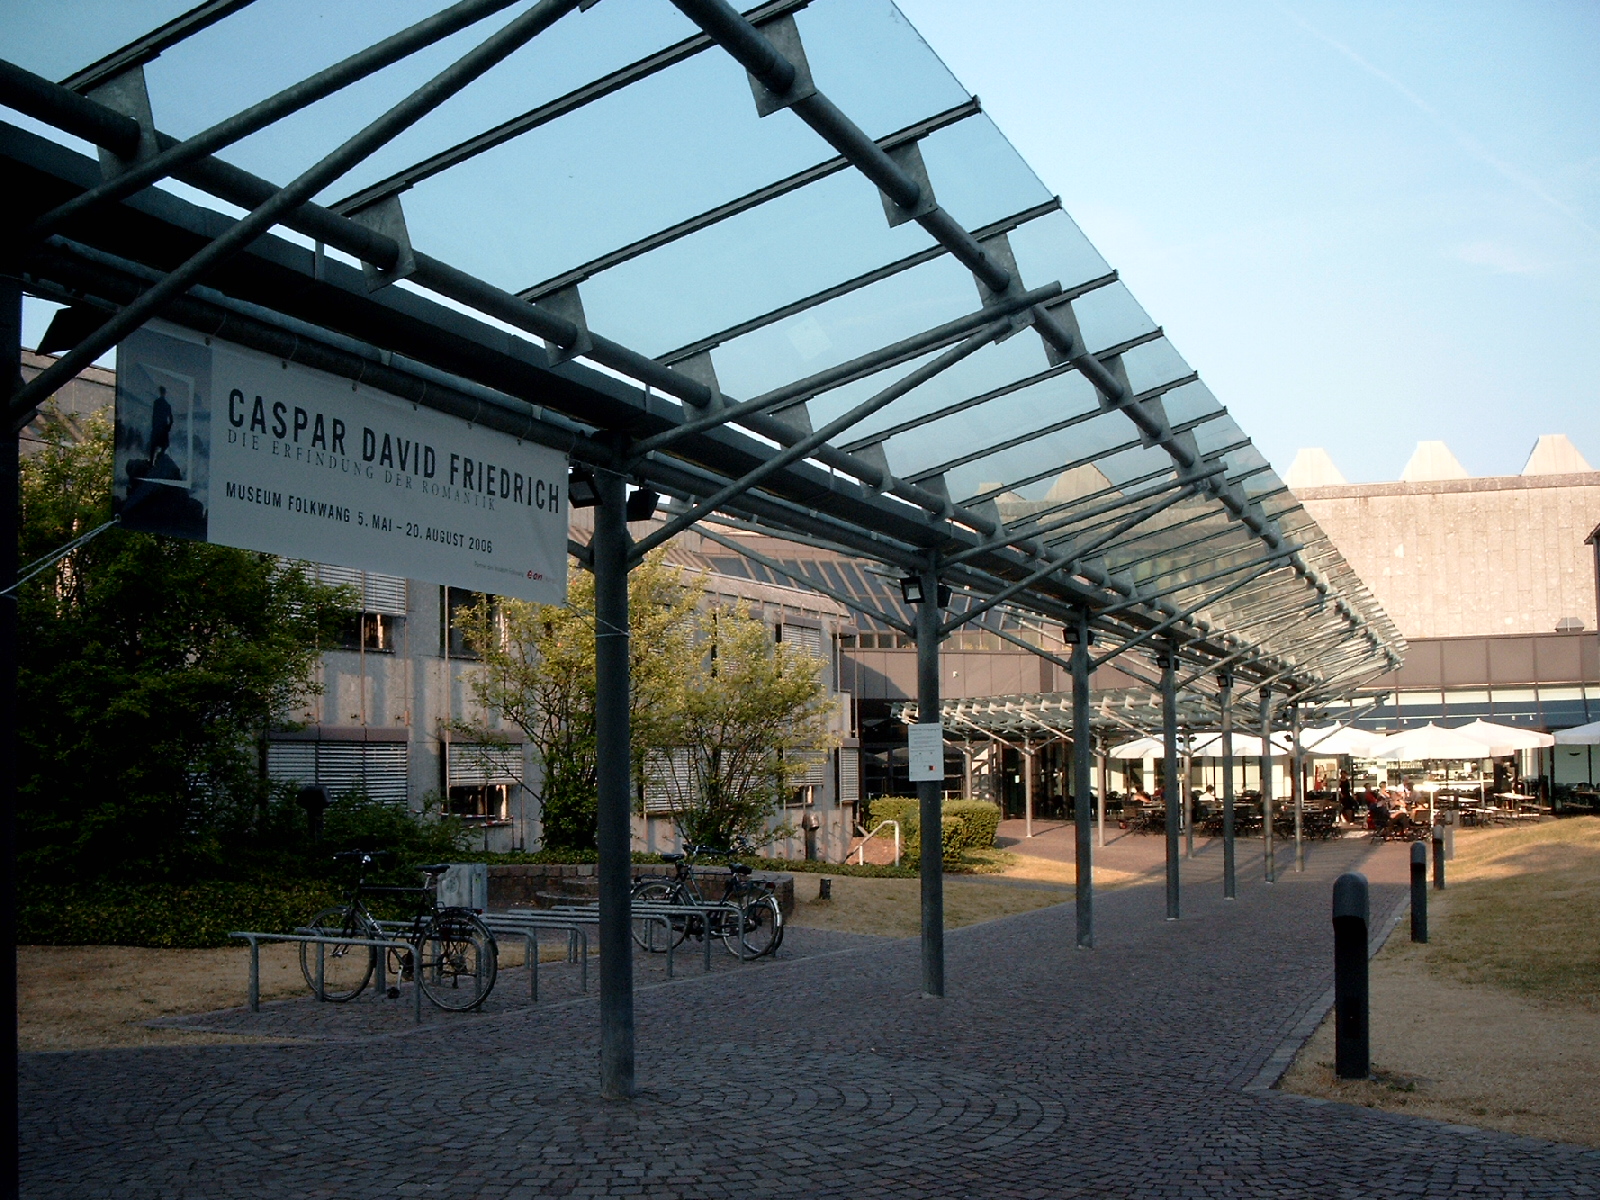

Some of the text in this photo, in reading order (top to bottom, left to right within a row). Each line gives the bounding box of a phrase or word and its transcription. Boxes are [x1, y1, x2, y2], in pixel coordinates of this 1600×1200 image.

[227, 428, 496, 511] DIE ERFINDUNG DER ROMANTIK
[228, 388, 560, 514] CASPAR DAVID FRIEDRICH
[225, 481, 282, 508] MUSEUM
[287, 494, 351, 523] FOLKWANG
[371, 514, 393, 532] MAI
[425, 526, 465, 549] AUGUST
[468, 536, 493, 554] 2006
